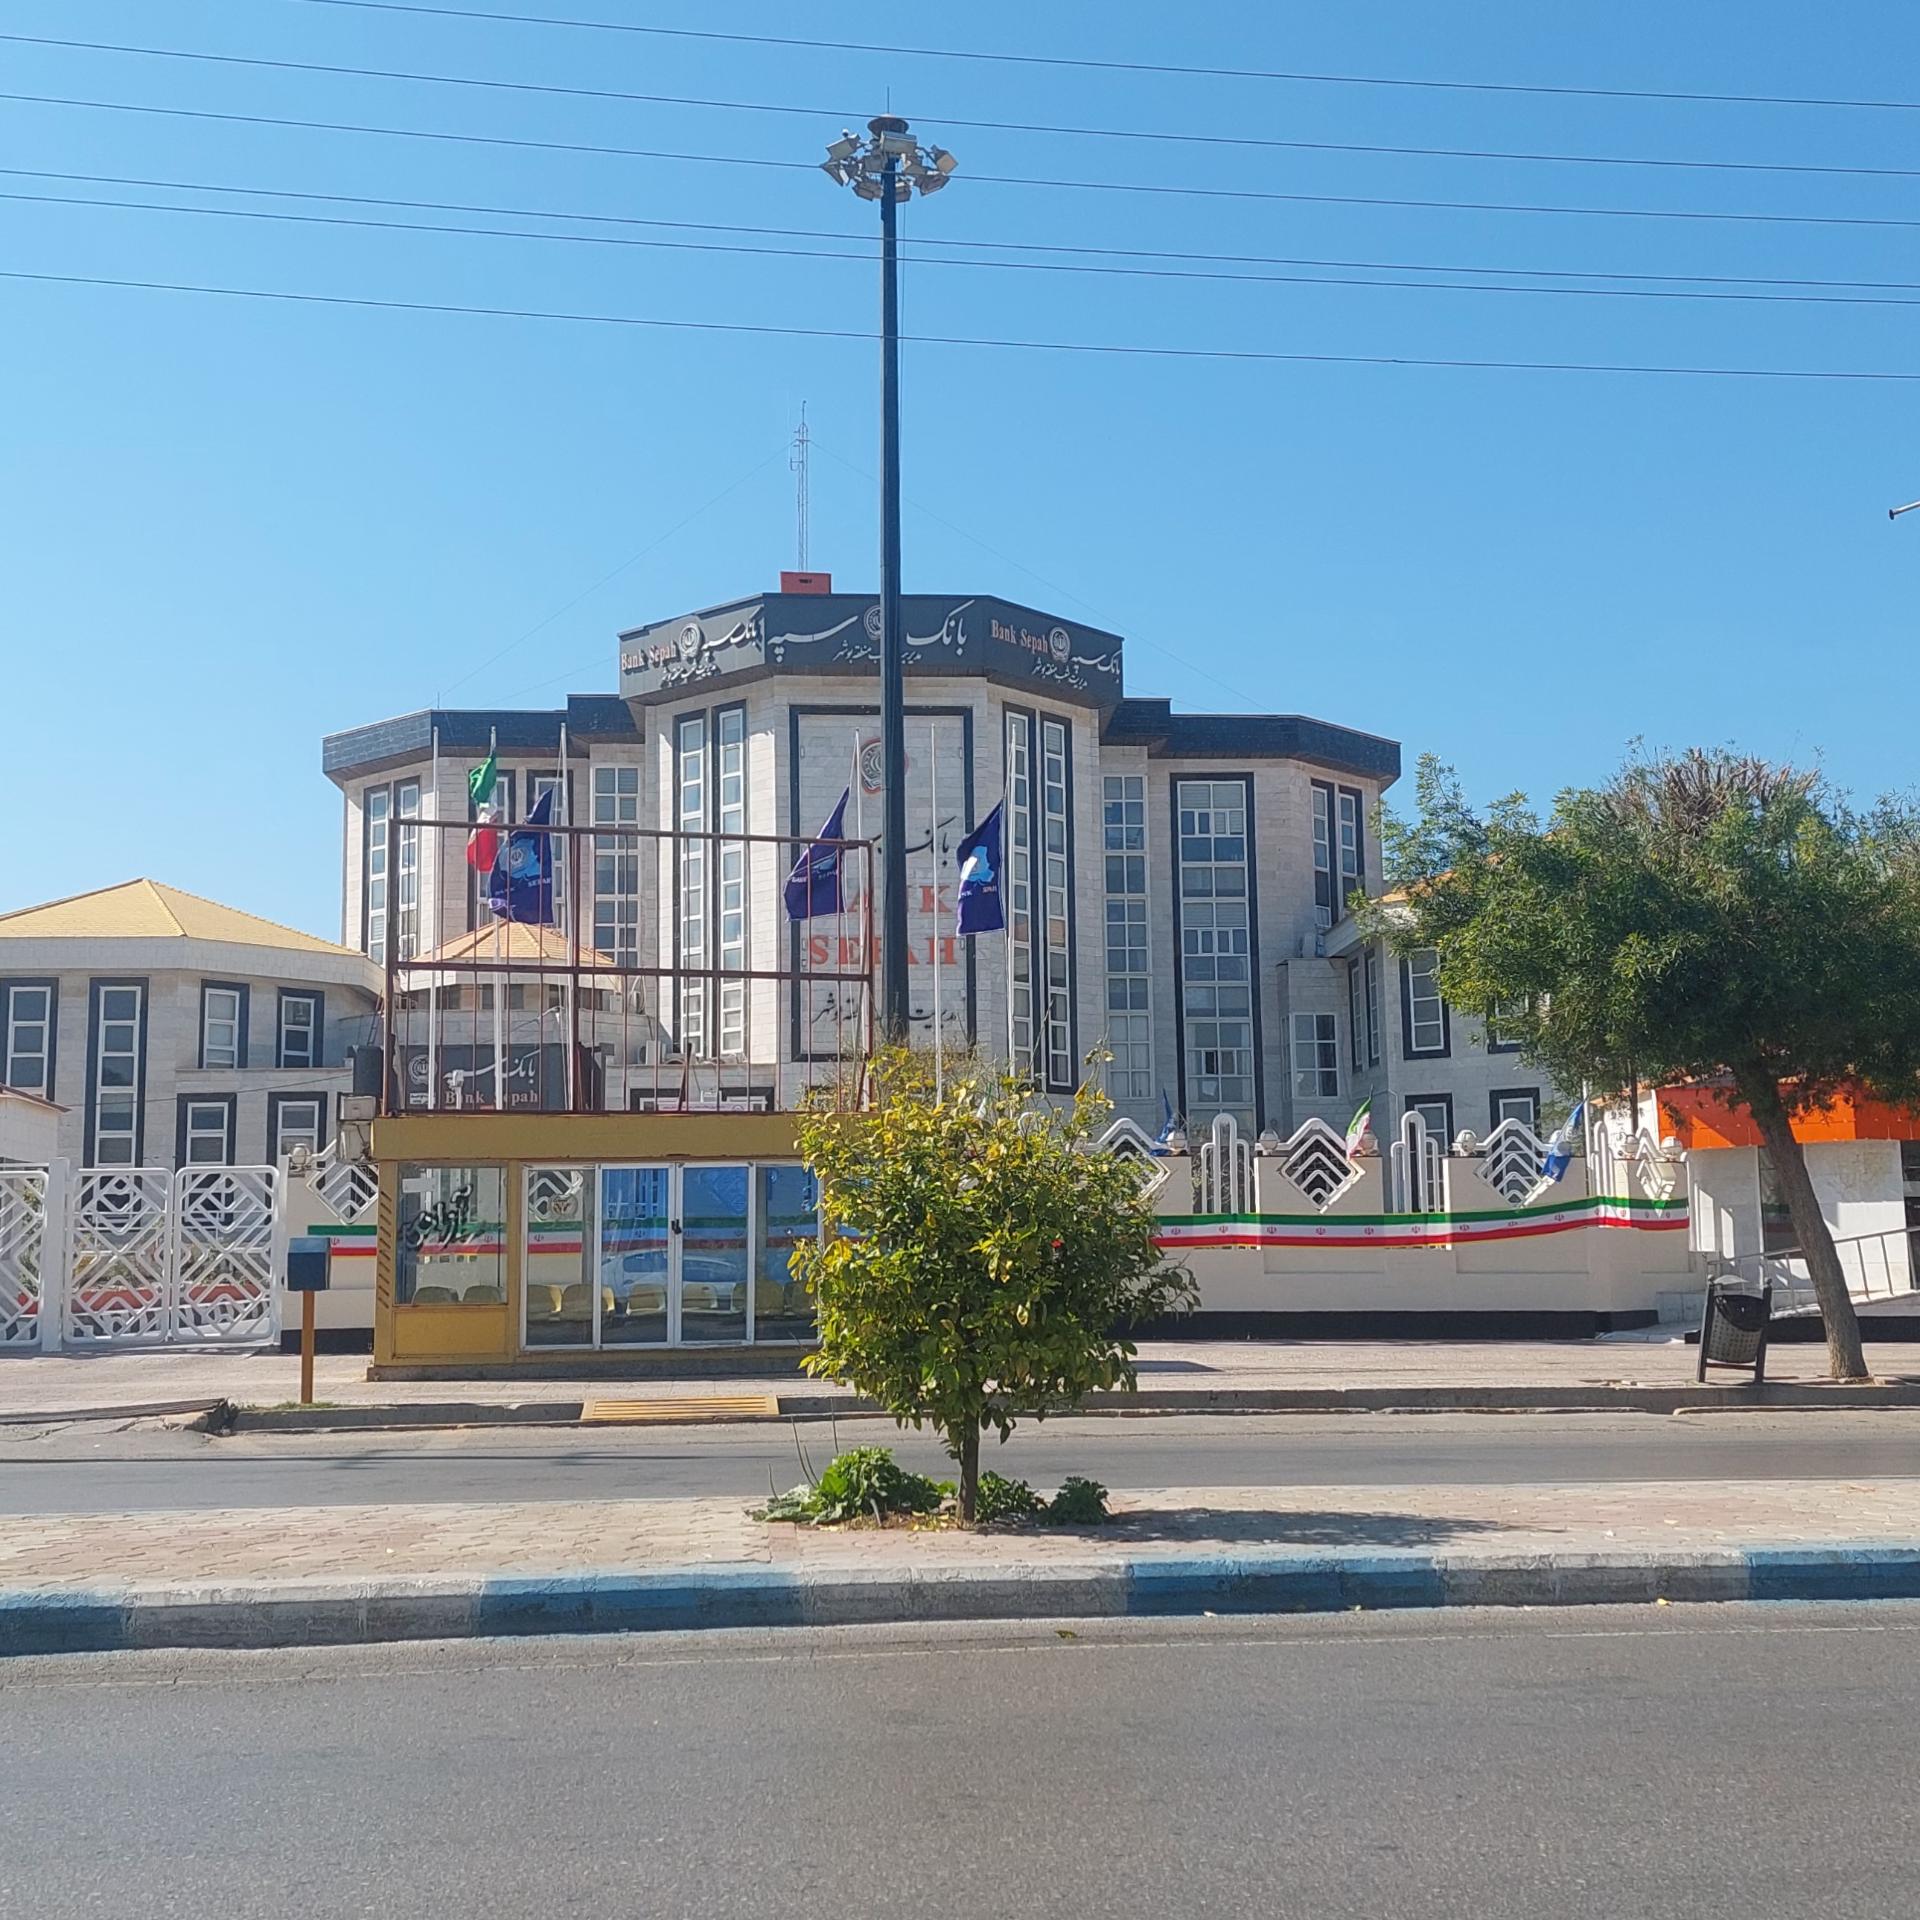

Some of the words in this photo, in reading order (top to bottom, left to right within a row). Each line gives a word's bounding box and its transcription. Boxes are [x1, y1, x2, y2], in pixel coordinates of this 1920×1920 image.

[701, 622, 741, 663] سپه
[730, 604, 764, 647] بانک
[767, 615, 859, 663] سپه
[906, 600, 976, 656] بانک
[991, 619, 1017, 645] Bank
[1020, 627, 1049, 655] Sepah
[621, 648, 645, 671] Bank
[649, 639, 677, 666] Sepah
[1070, 652, 1107, 674] سپه
[1097, 649, 1122, 684] بانک
[499, 1049, 542, 1085] بانک
[445, 1090, 485, 1104] Bnk
